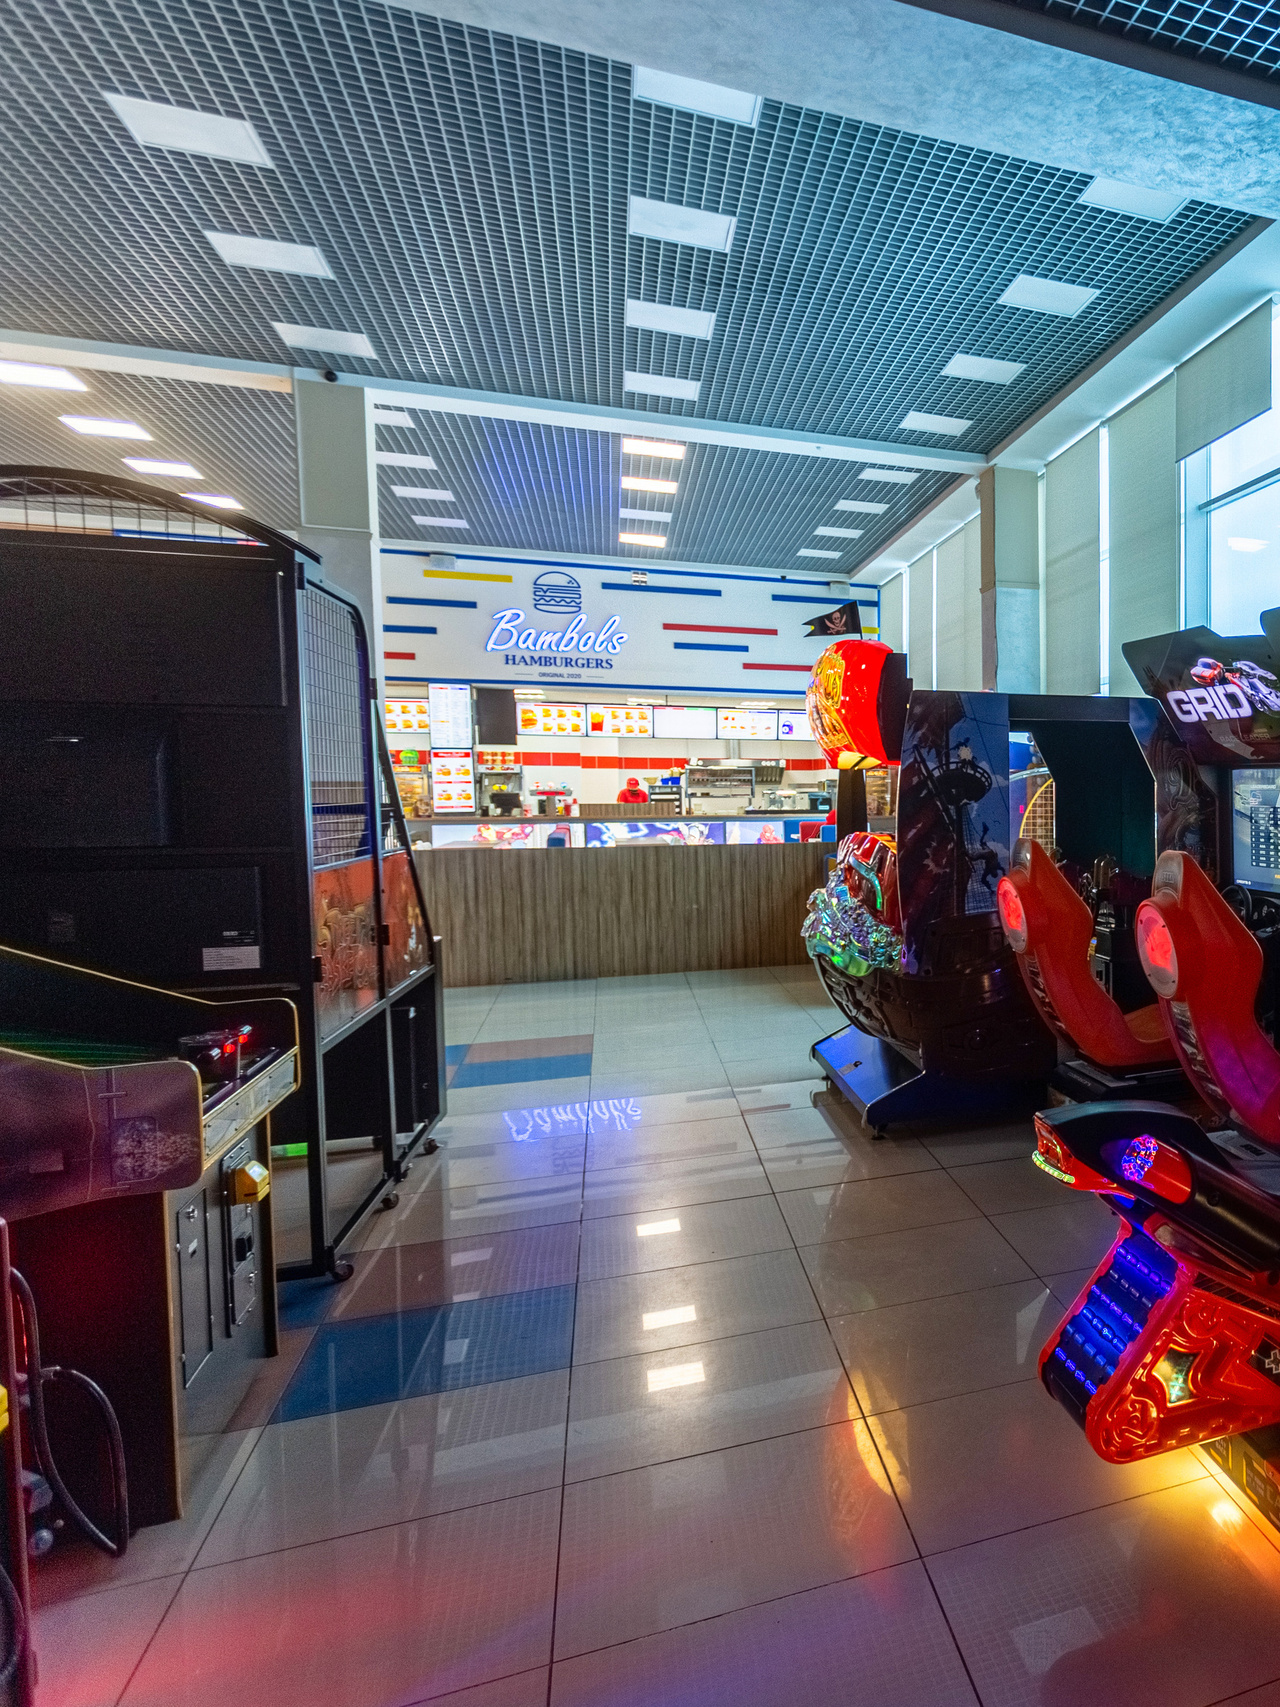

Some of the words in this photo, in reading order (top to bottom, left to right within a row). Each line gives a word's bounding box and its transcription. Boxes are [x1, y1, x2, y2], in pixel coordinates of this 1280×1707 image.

[486, 607, 629, 655] Bambols
[504, 654, 613, 670] HAMBURGERS
[1166, 684, 1252, 724] GRID
